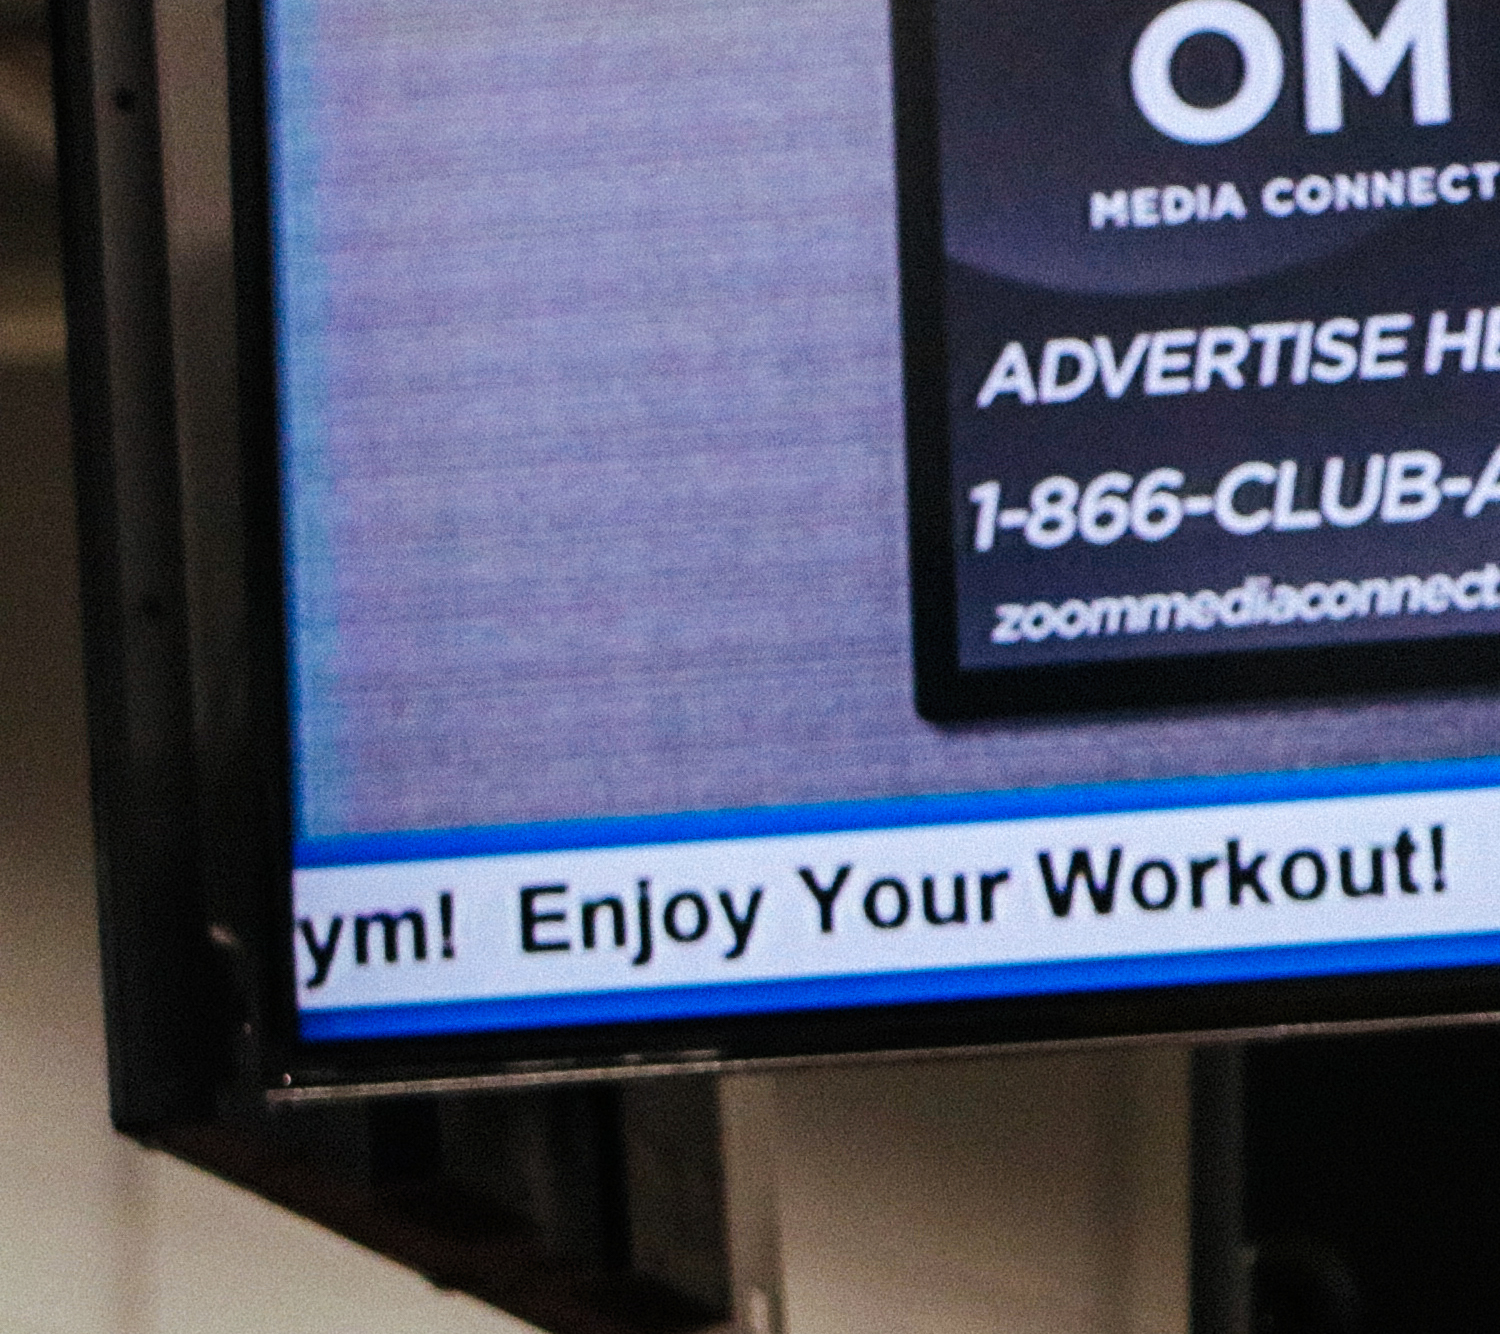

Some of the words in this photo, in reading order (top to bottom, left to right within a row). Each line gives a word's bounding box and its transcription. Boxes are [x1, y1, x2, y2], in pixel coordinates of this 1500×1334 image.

[1090, 181, 1247, 230] MEDIA
[975, 313, 1412, 409] ADVERTISE
[300, 891, 456, 989] ym!
[518, 878, 764, 966] Enjoy
[798, 863, 1011, 934] Your
[1036, 822, 1449, 920] Workout!
